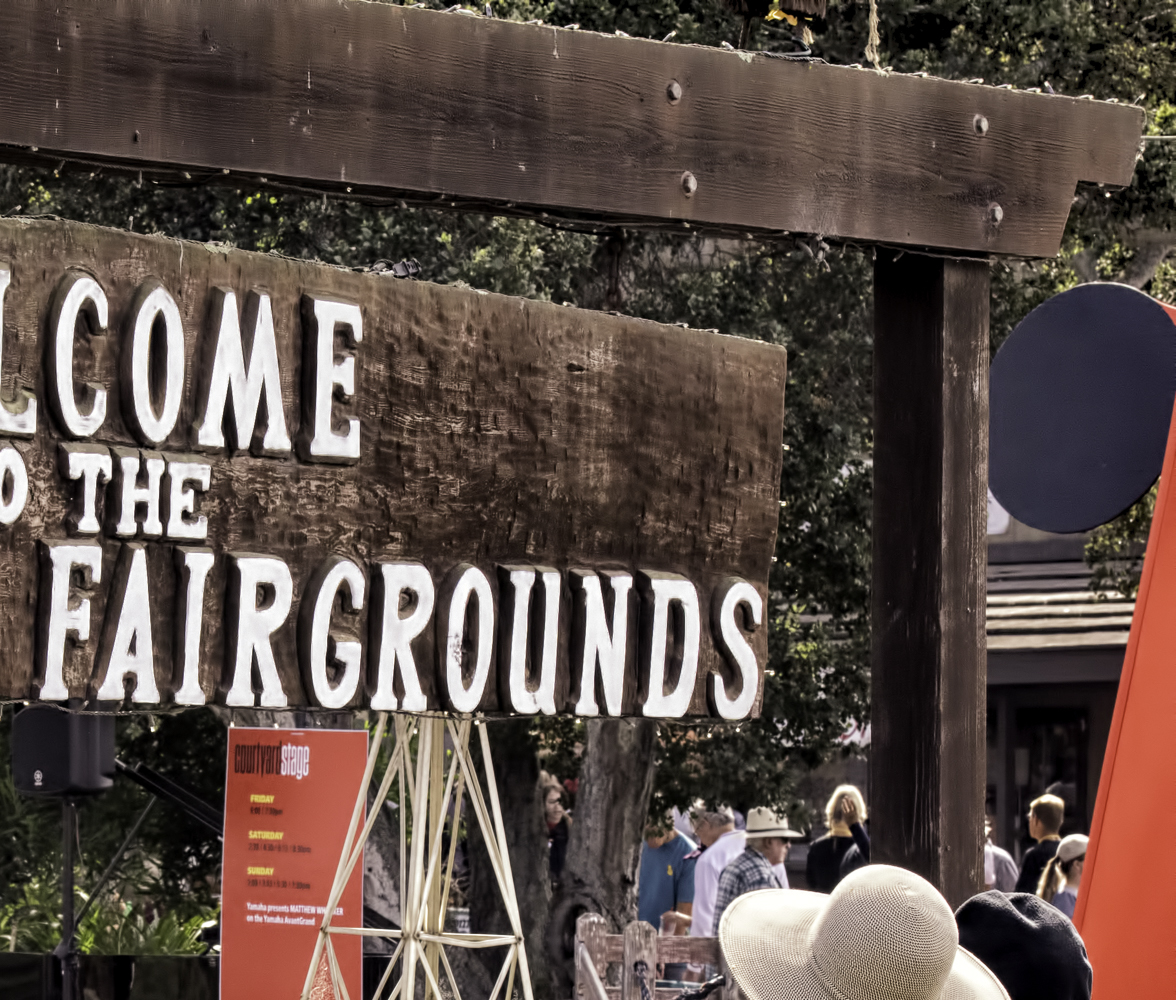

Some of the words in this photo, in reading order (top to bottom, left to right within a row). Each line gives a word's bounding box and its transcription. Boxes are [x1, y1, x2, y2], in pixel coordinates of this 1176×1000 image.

[67, 450, 213, 541] THE
[38, 543, 764, 721] FAIRGROUNDS
[250, 794, 275, 804] FRIDAY
[248, 830, 284, 840] SATURDAY
[247, 867, 274, 876] SUNDAY
[246, 902, 267, 911] Yamaha
[267, 904, 289, 914] presents
[290, 904, 316, 914] MATTHEW
[246, 915, 254, 923] on
[254, 914, 263, 923] the
[264, 915, 284, 924] Yamaha
[284, 916, 316, 926] AvantGrand
